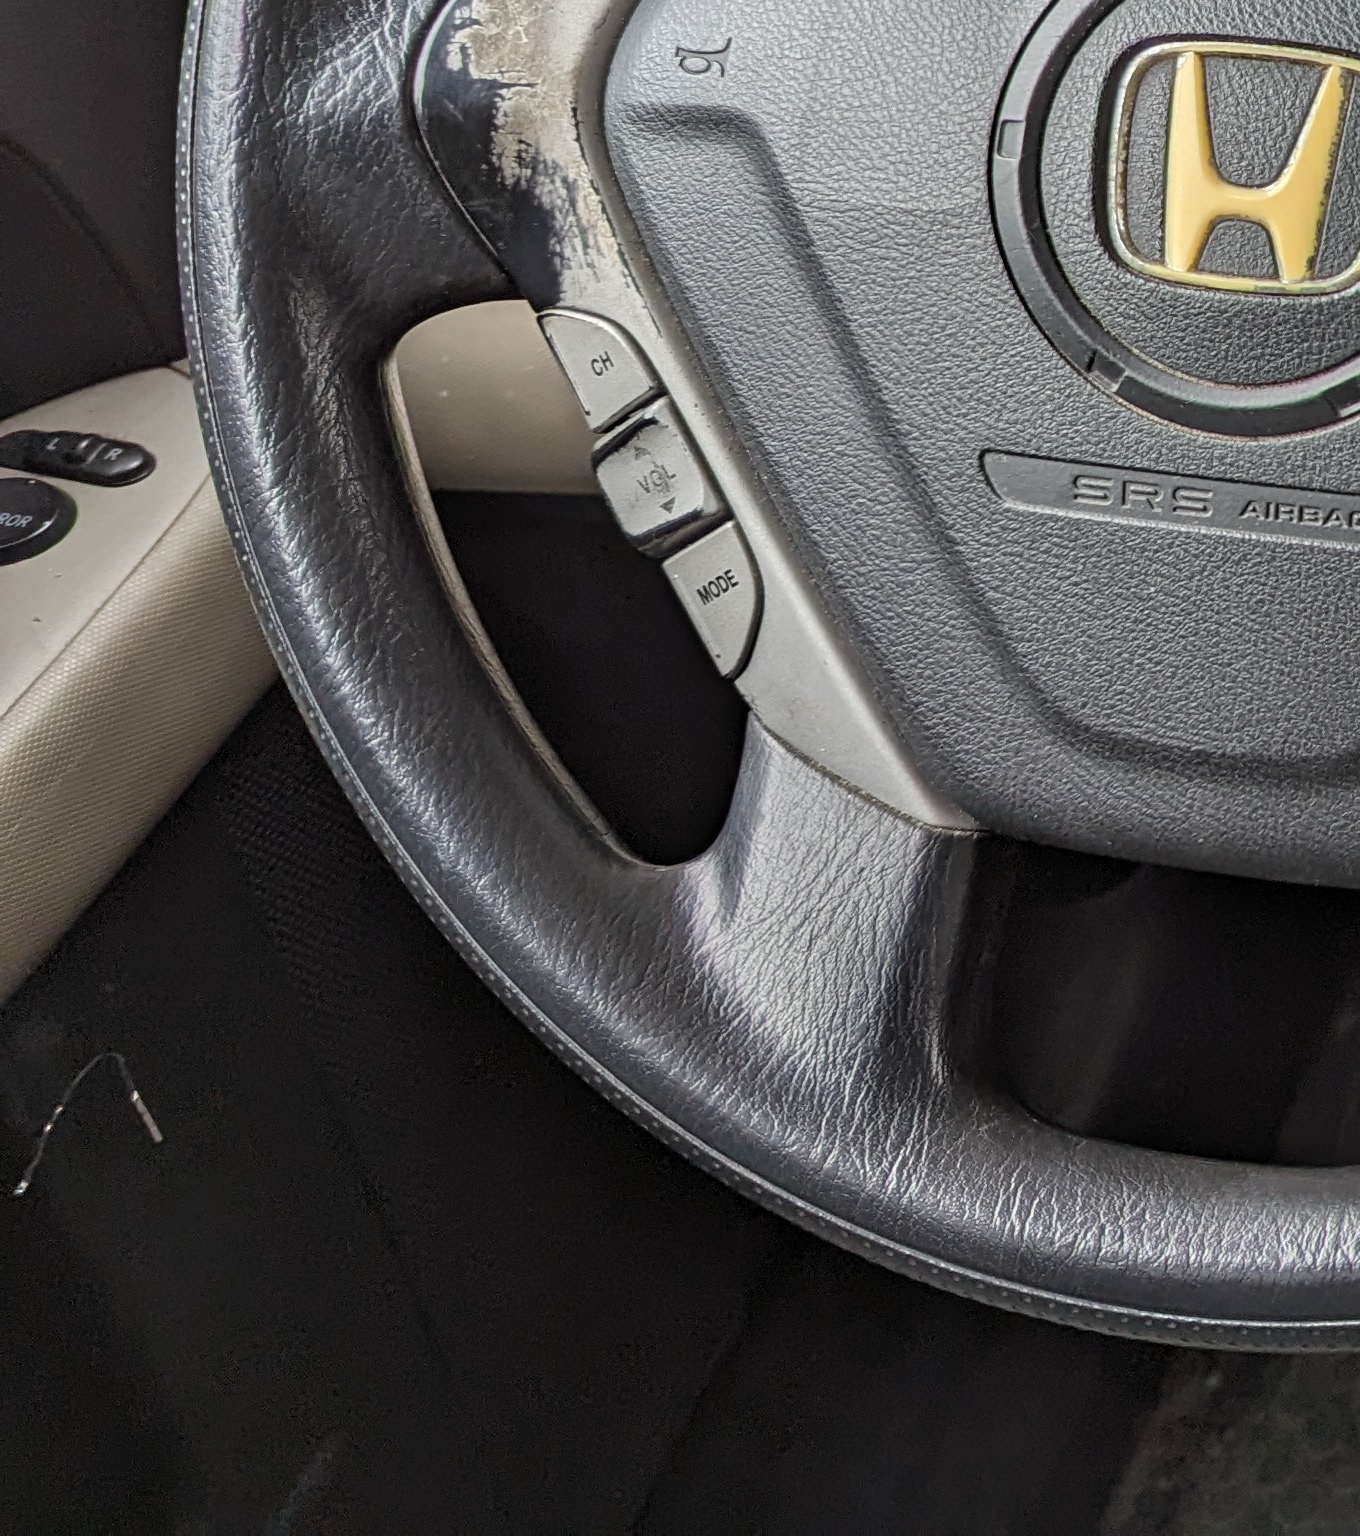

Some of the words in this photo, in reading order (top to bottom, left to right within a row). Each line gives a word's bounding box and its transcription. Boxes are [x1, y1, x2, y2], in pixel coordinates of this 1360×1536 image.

[590, 350, 615, 377] CH
[46, 437, 60, 450] L
[104, 447, 123, 461] R
[635, 463, 677, 494] VOL
[1071, 474, 1214, 519] SRS
[696, 568, 740, 606] MODE
